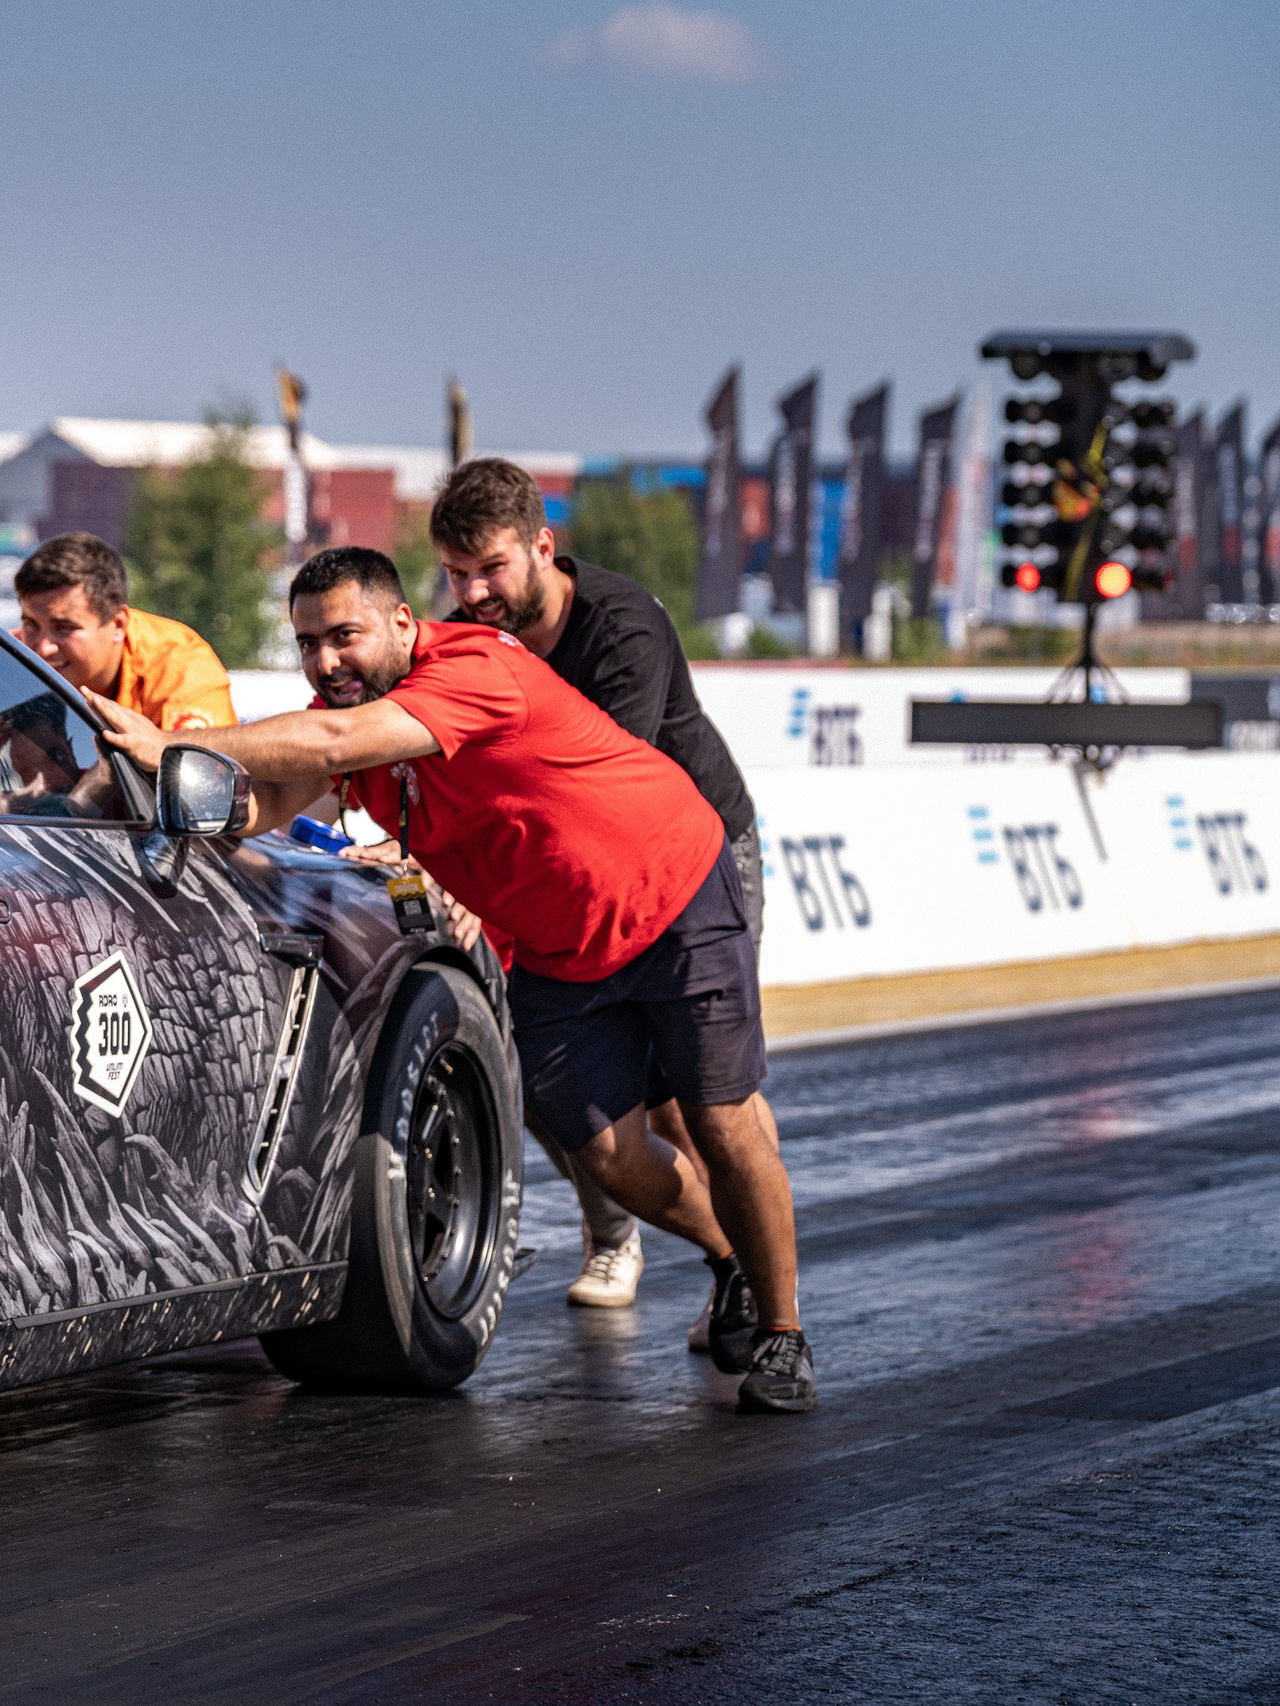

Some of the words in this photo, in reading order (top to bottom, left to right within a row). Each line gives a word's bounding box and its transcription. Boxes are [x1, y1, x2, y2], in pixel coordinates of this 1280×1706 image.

[780, 834, 872, 932] ВТБ
[1003, 822, 1083, 913] ВТБ
[1197, 811, 1269, 896] ВТБ
[98, 1012, 130, 1056] 300
[108, 1071, 120, 1080] FEST
